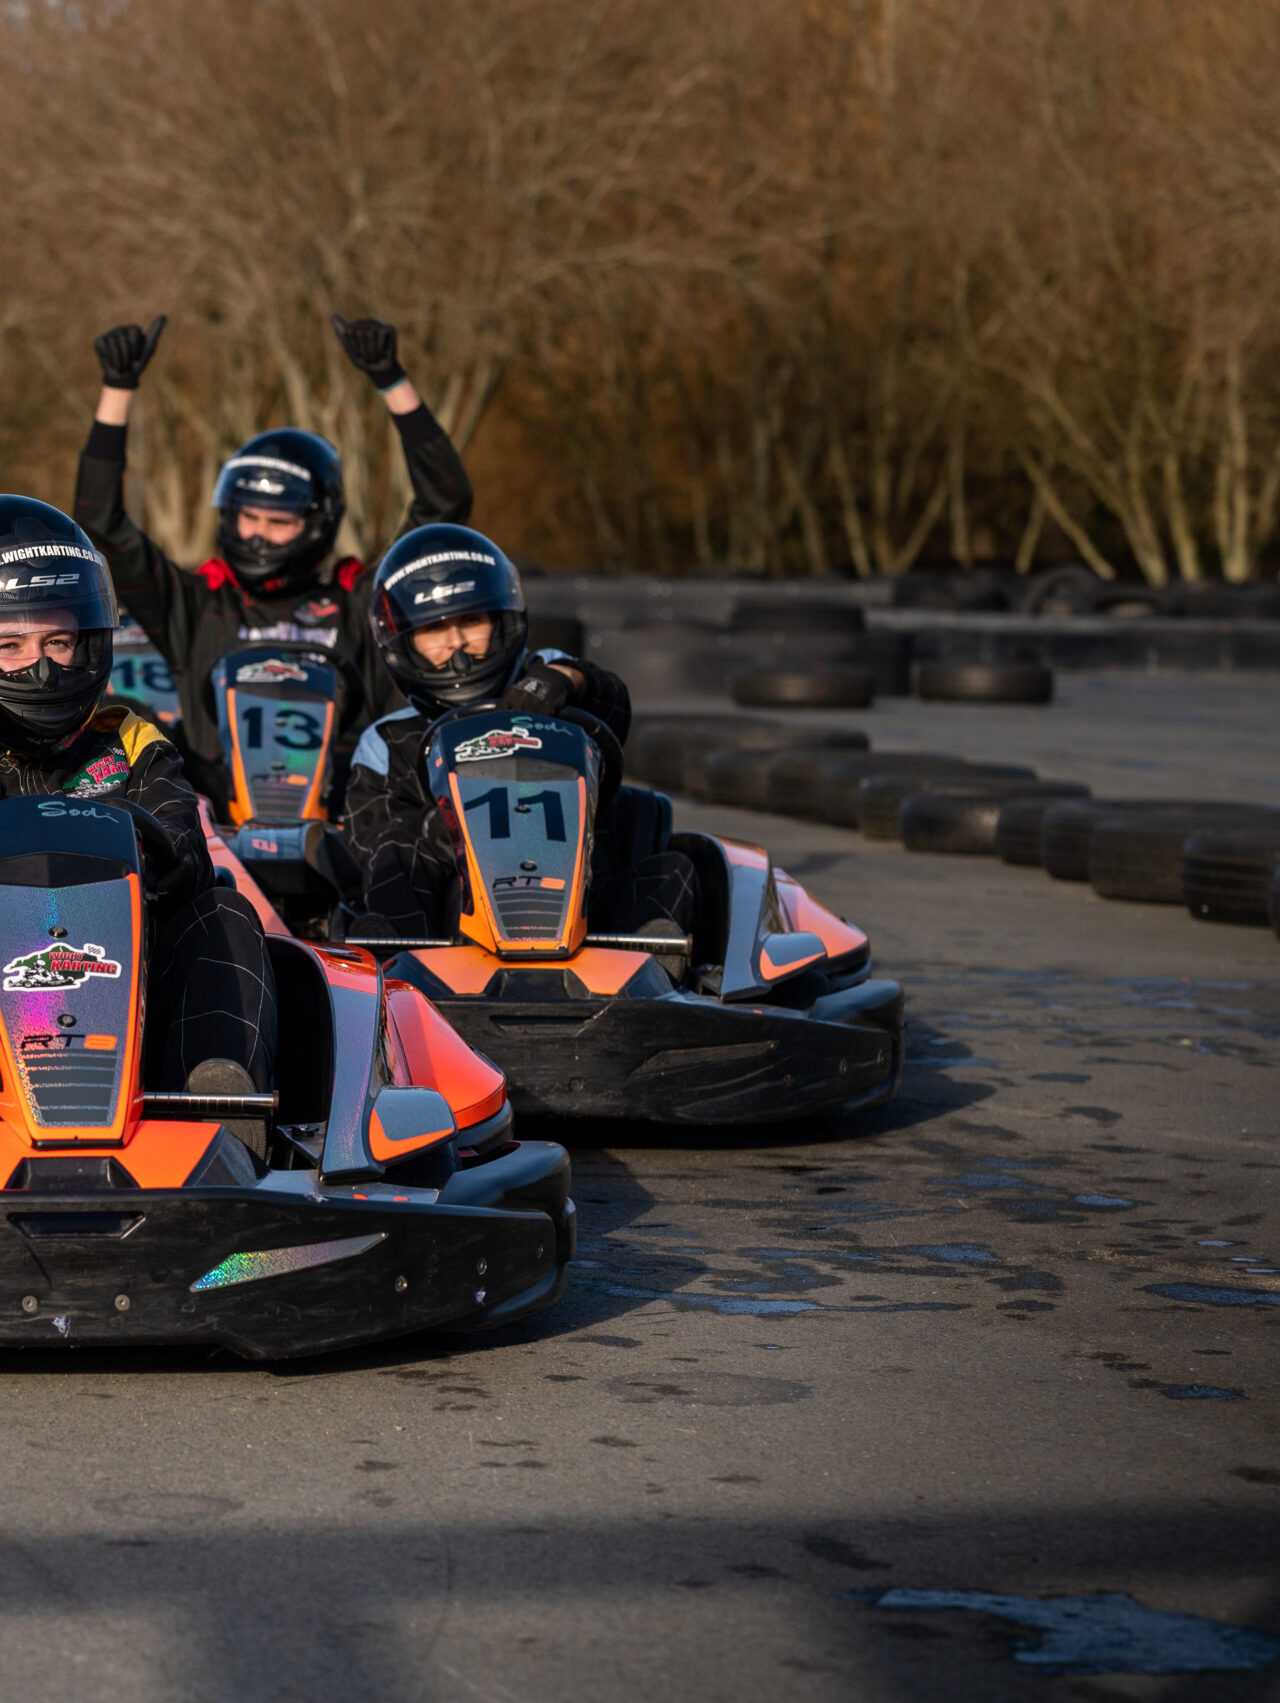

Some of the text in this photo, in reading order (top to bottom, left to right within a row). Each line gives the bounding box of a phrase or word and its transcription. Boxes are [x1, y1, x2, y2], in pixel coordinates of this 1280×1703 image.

[5, 573, 80, 590] LS2
[242, 706, 323, 750] 13
[86, 754, 115, 775] WIGHT
[464, 787, 567, 842] 11
[48, 951, 83, 960] WIGHT
[50, 959, 118, 975] KARTING
[21, 1033, 118, 1050] RT8
